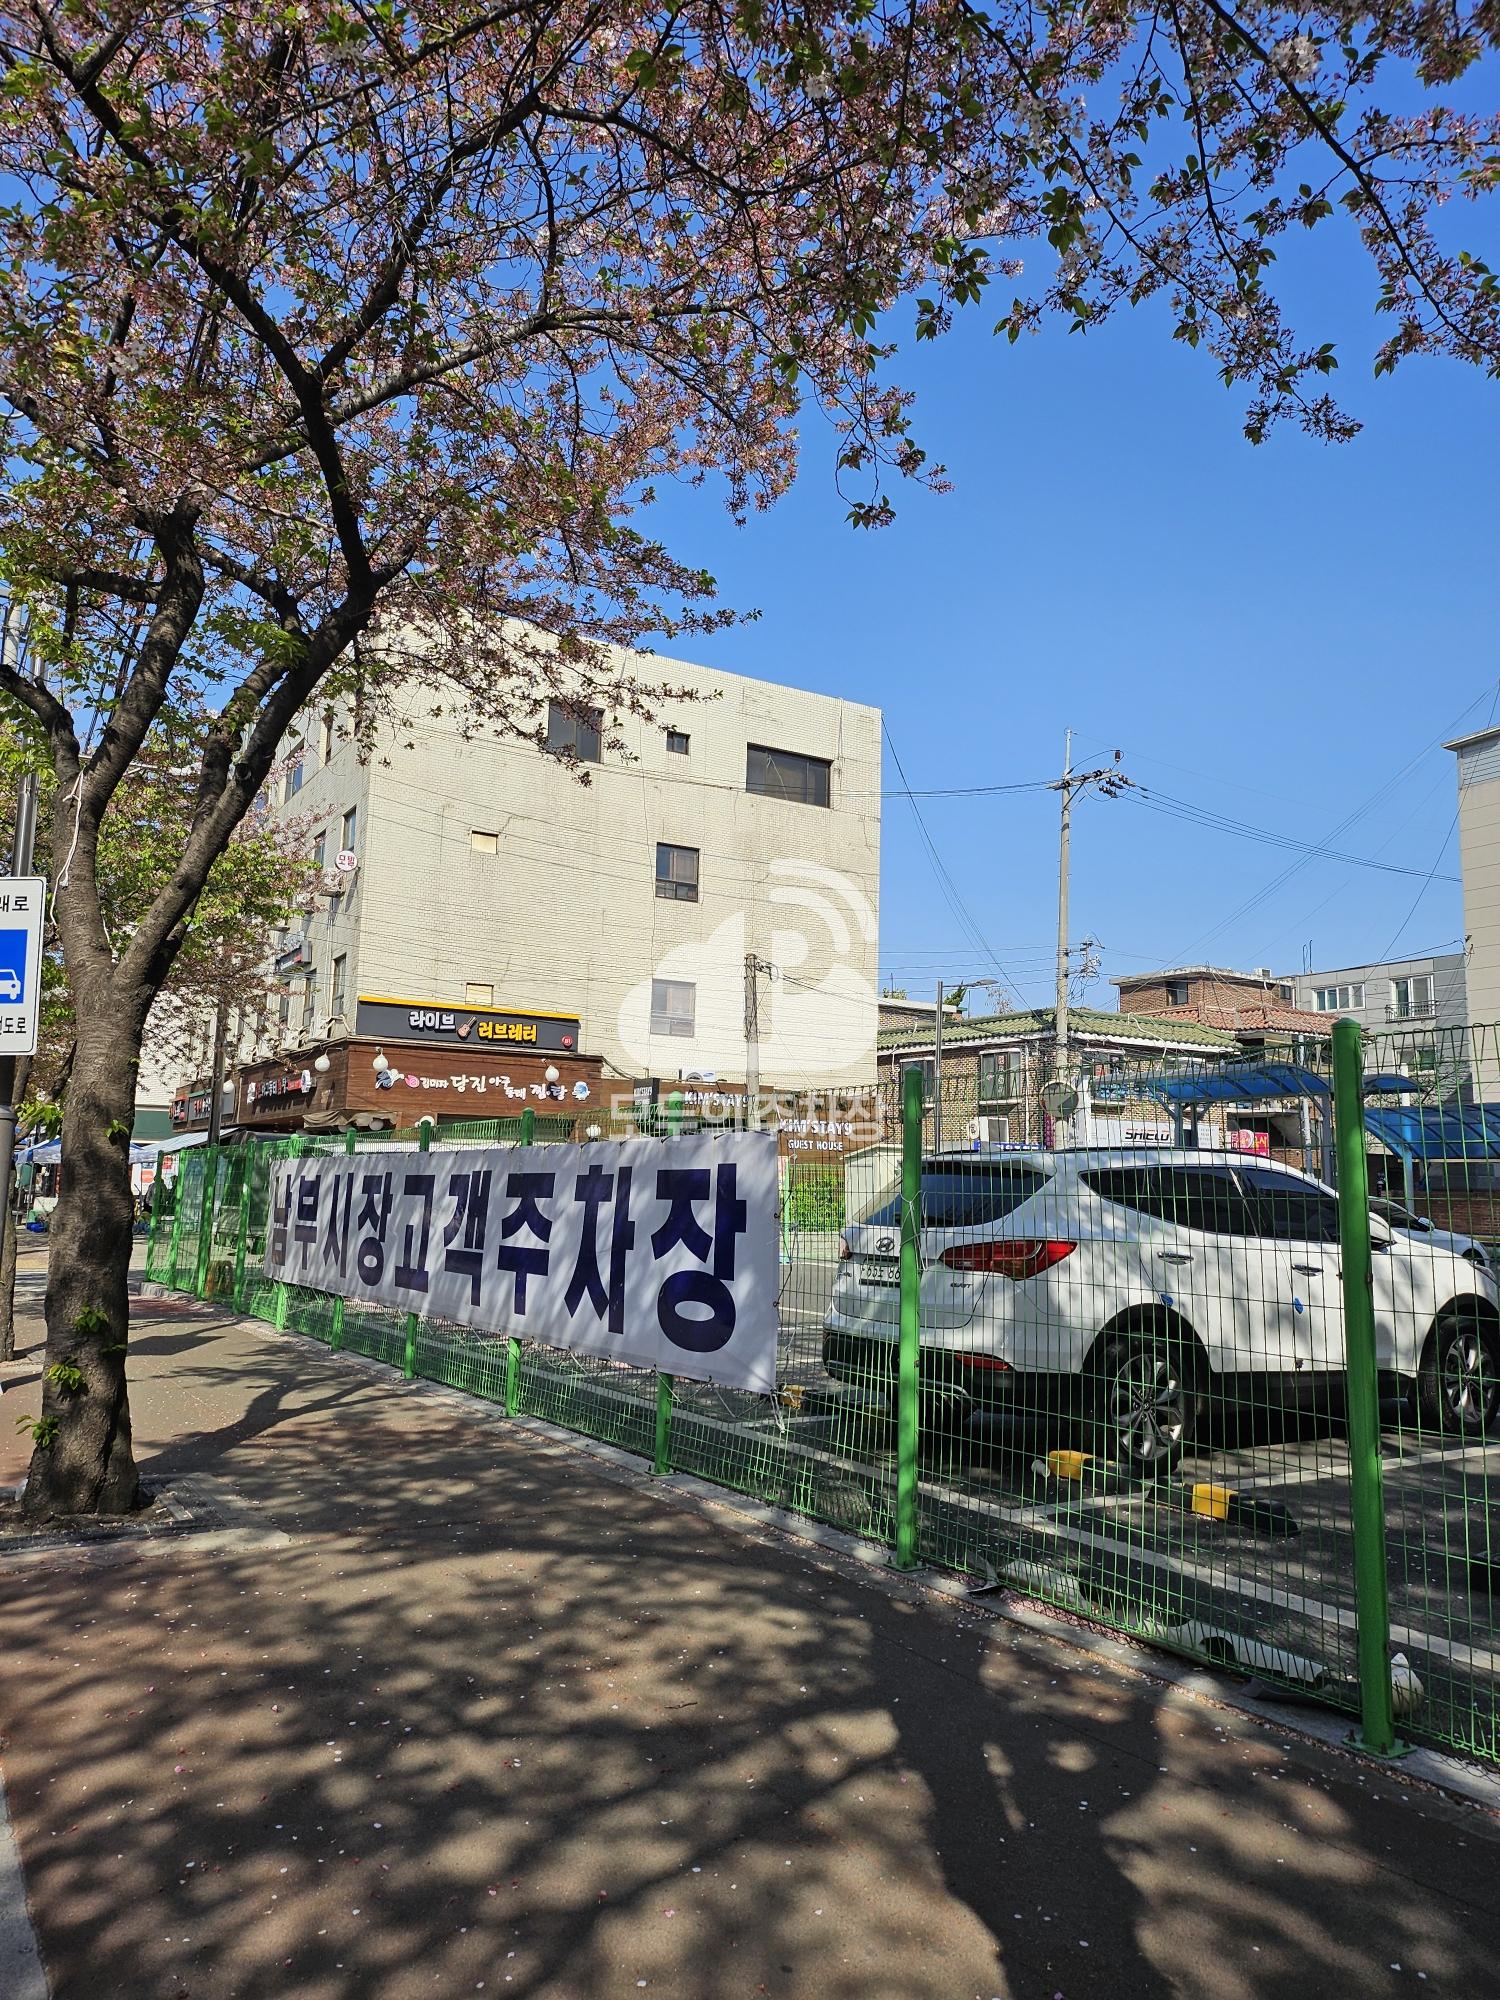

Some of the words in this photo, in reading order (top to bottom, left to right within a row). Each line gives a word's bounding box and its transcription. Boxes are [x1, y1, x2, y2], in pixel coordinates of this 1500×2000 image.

[409, 1010, 456, 1030] 라이브
[478, 1021, 538, 1042] 러브레터
[450, 1073, 487, 1093] 당진
[488, 1075, 511, 1089] 아구
[788, 1139, 814, 1150] GUEST
[816, 1140, 844, 1152] HOUSE
[271, 1163, 747, 1353] 남부시장고객주차장
